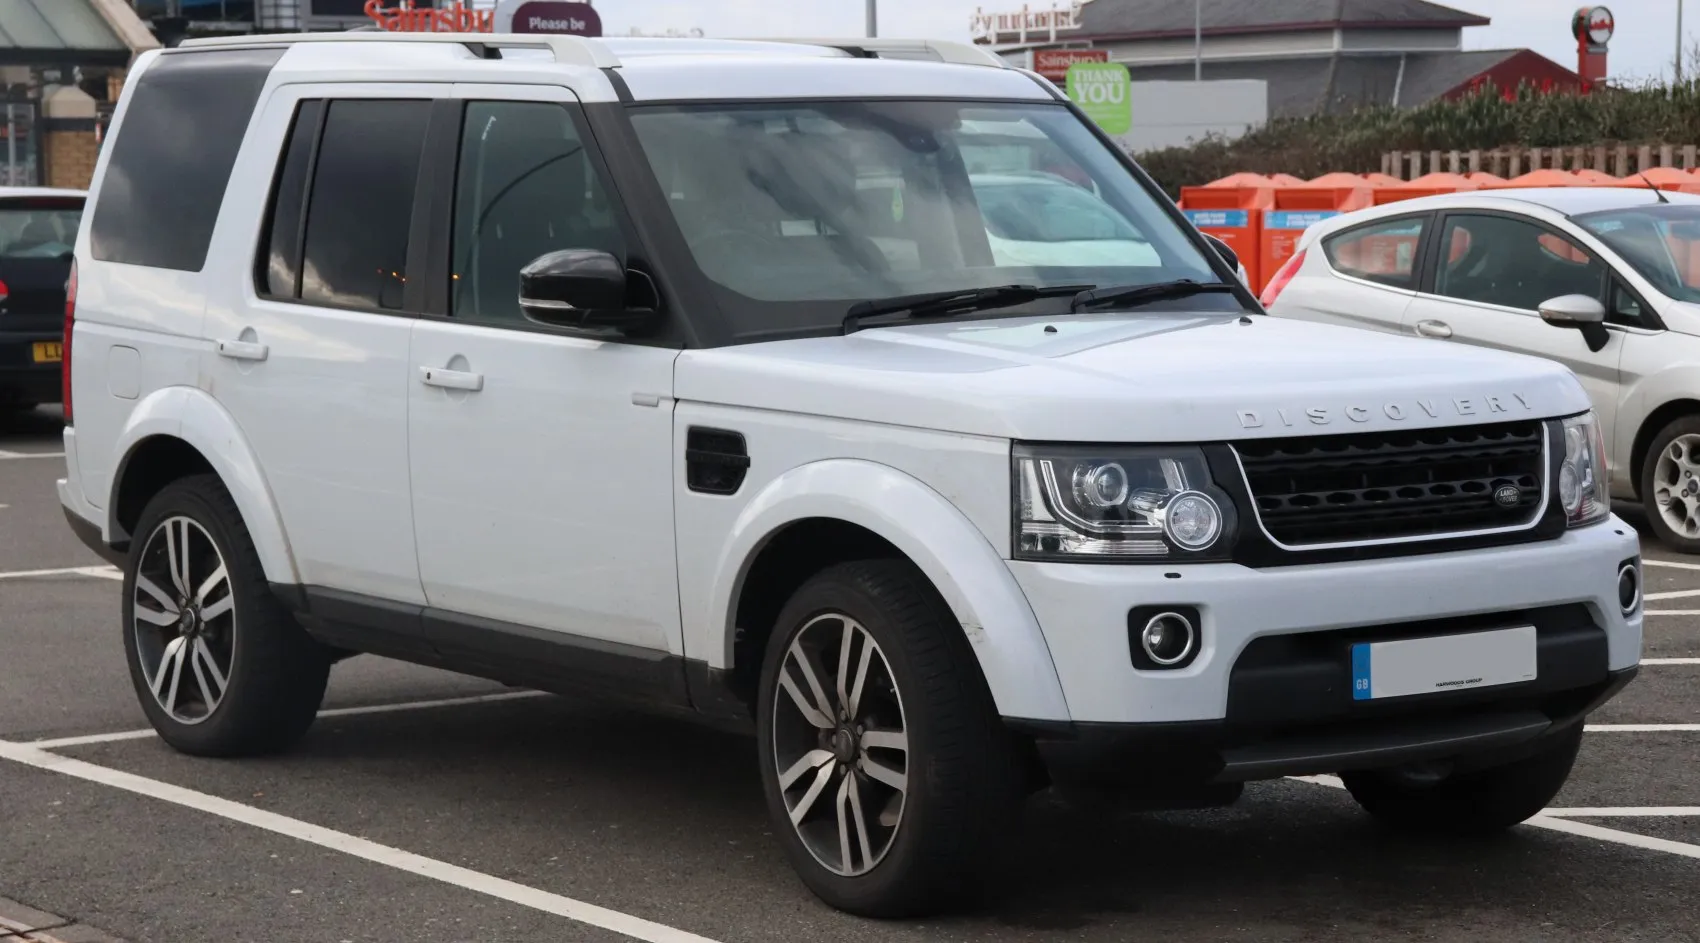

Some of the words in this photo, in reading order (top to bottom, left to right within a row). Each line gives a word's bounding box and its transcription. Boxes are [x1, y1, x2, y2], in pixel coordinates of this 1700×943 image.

[529, 16, 568, 30] Please
[570, 16, 586, 30] be
[1074, 69, 1123, 82] THANK
[1074, 82, 1125, 104] YOU
[1236, 392, 1532, 429] DISCOVERY
[1356, 678, 1369, 690] GB
